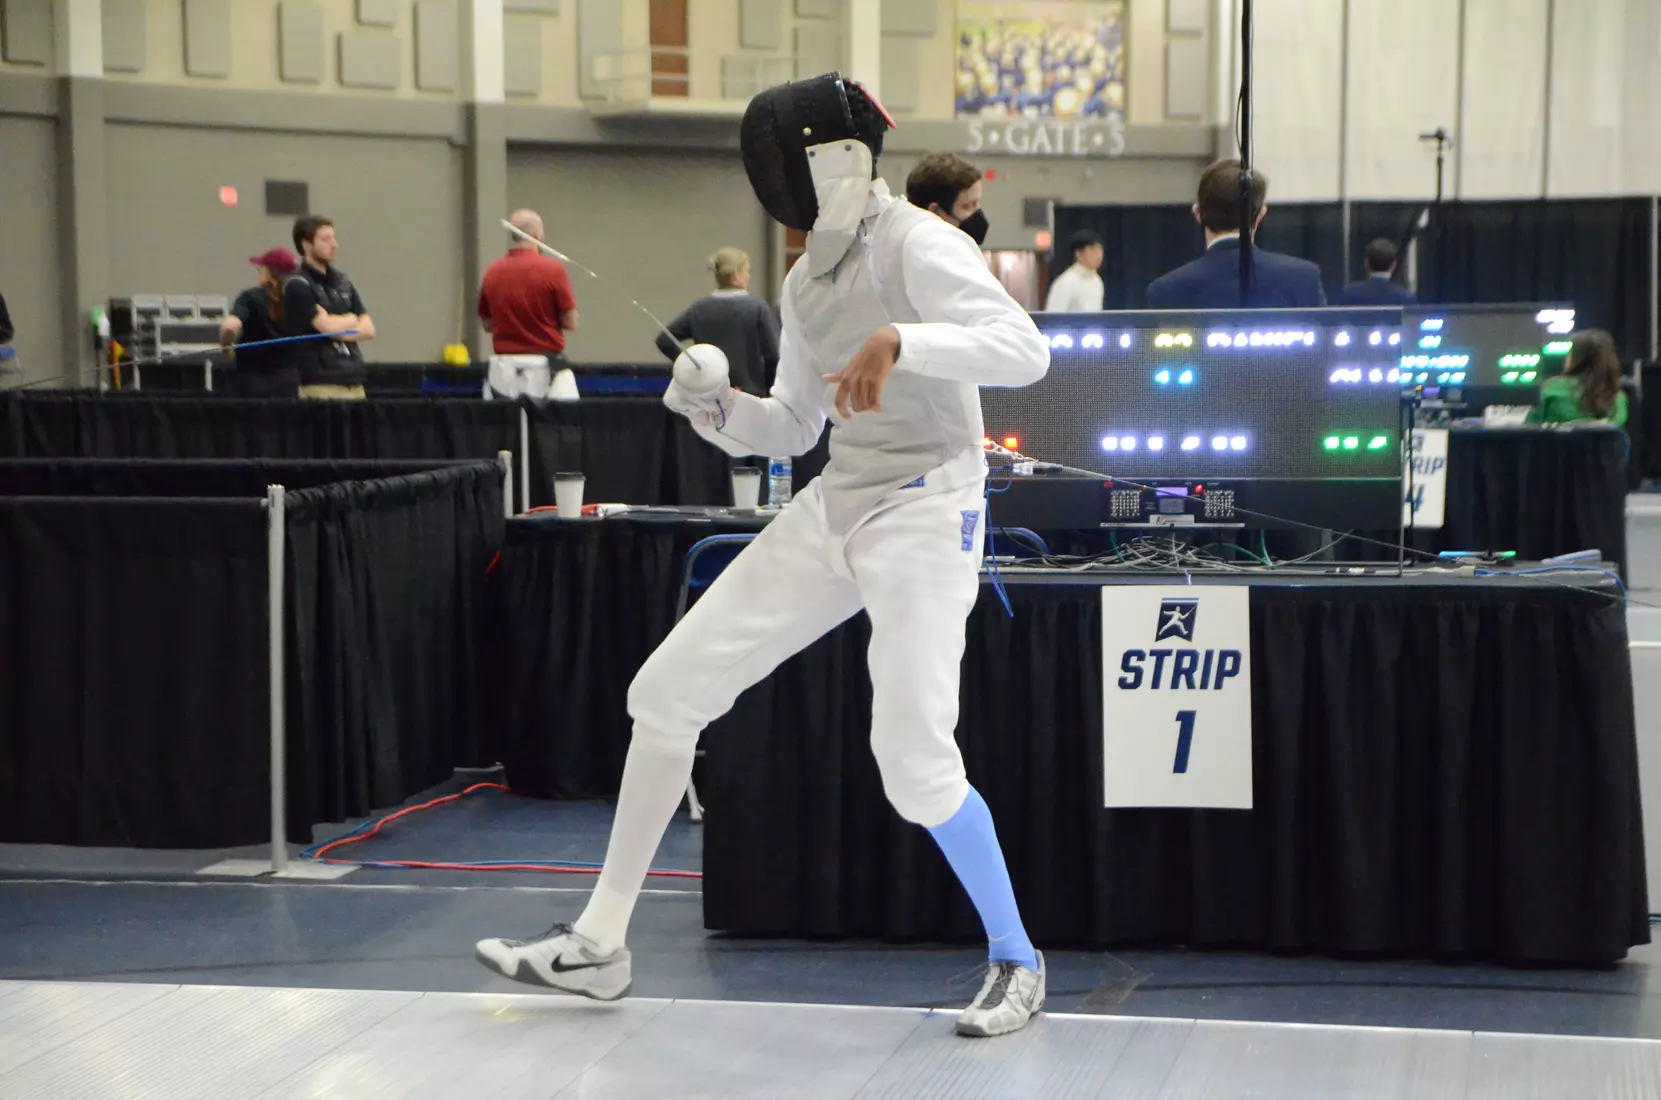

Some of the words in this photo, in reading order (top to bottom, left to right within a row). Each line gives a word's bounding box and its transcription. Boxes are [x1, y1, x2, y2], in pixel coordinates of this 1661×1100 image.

[1408, 456, 1444, 475] RIP
[1118, 649, 1242, 690] STRIP
[1173, 710, 1197, 774] 1
